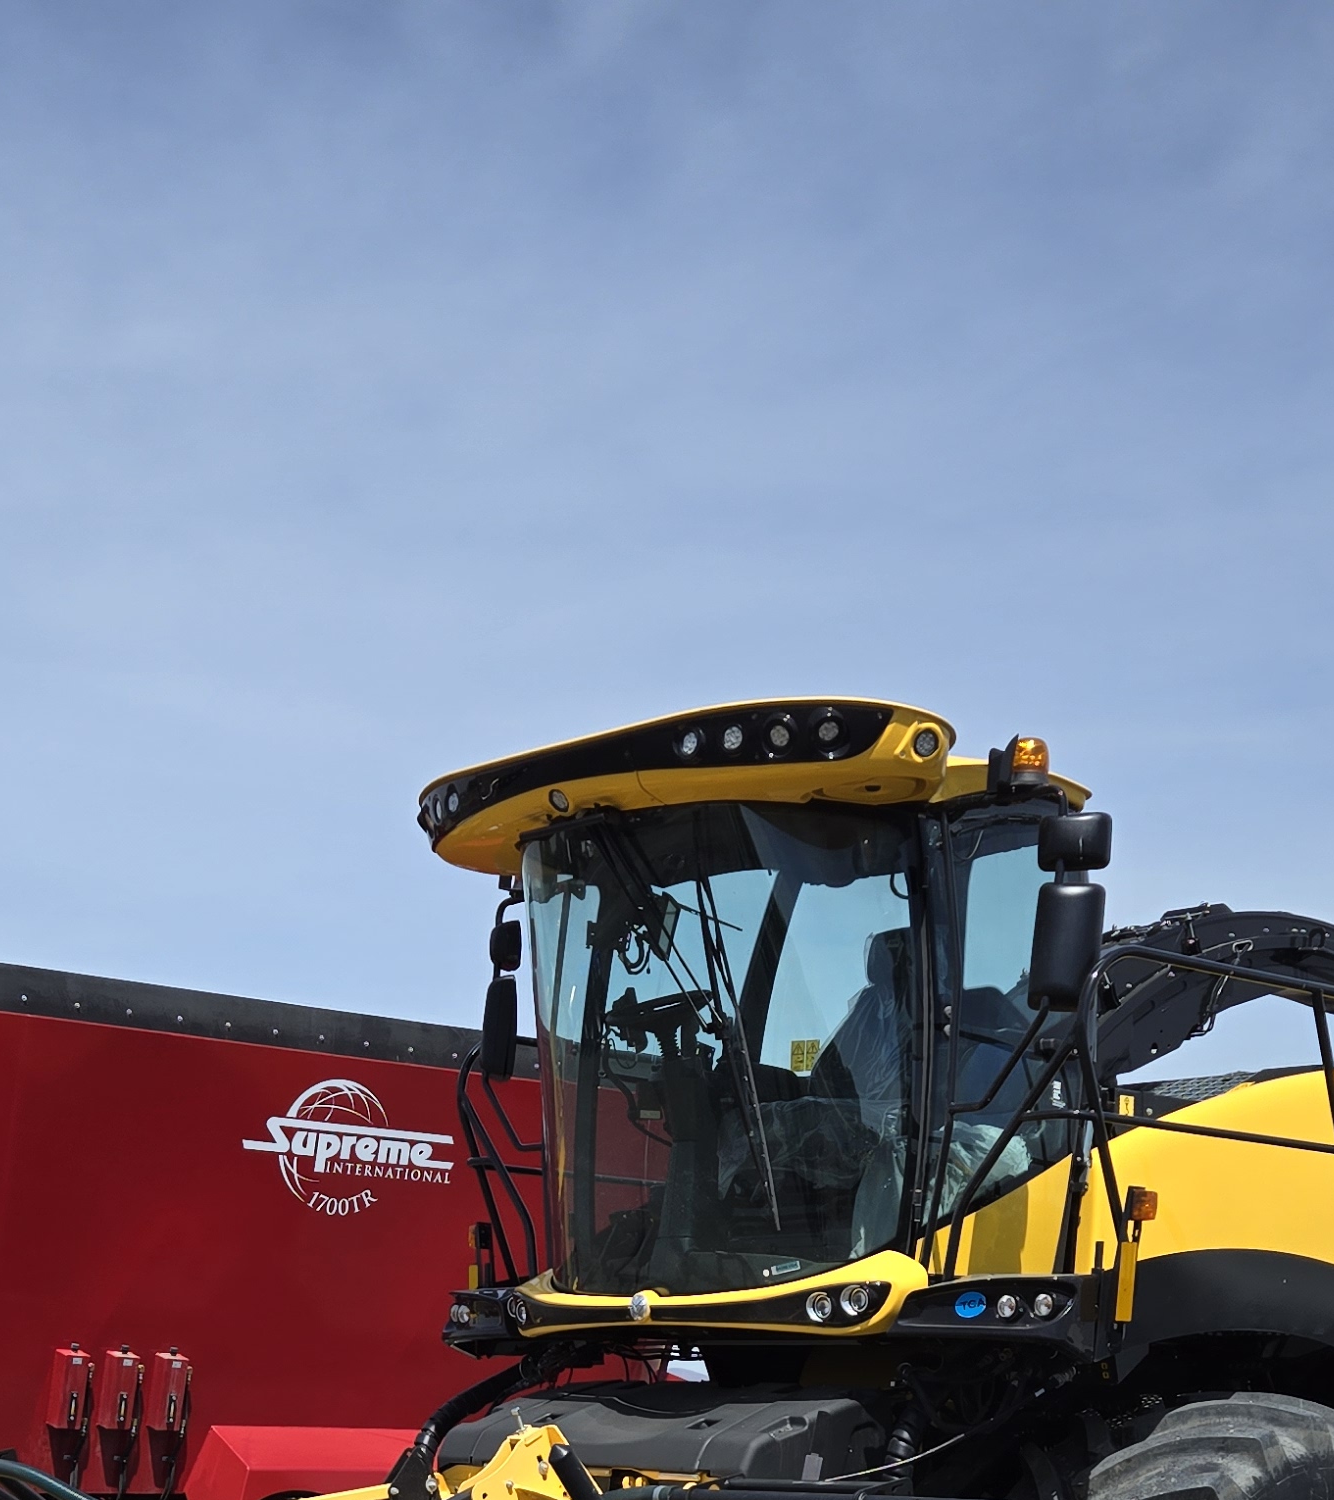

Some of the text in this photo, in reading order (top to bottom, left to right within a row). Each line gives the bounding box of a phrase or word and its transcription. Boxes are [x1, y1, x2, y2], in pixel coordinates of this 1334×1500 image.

[242, 1117, 454, 1173] Supreme
[325, 1160, 451, 1184] INTERNATIONAL
[307, 1188, 378, 1217] 1700TR
